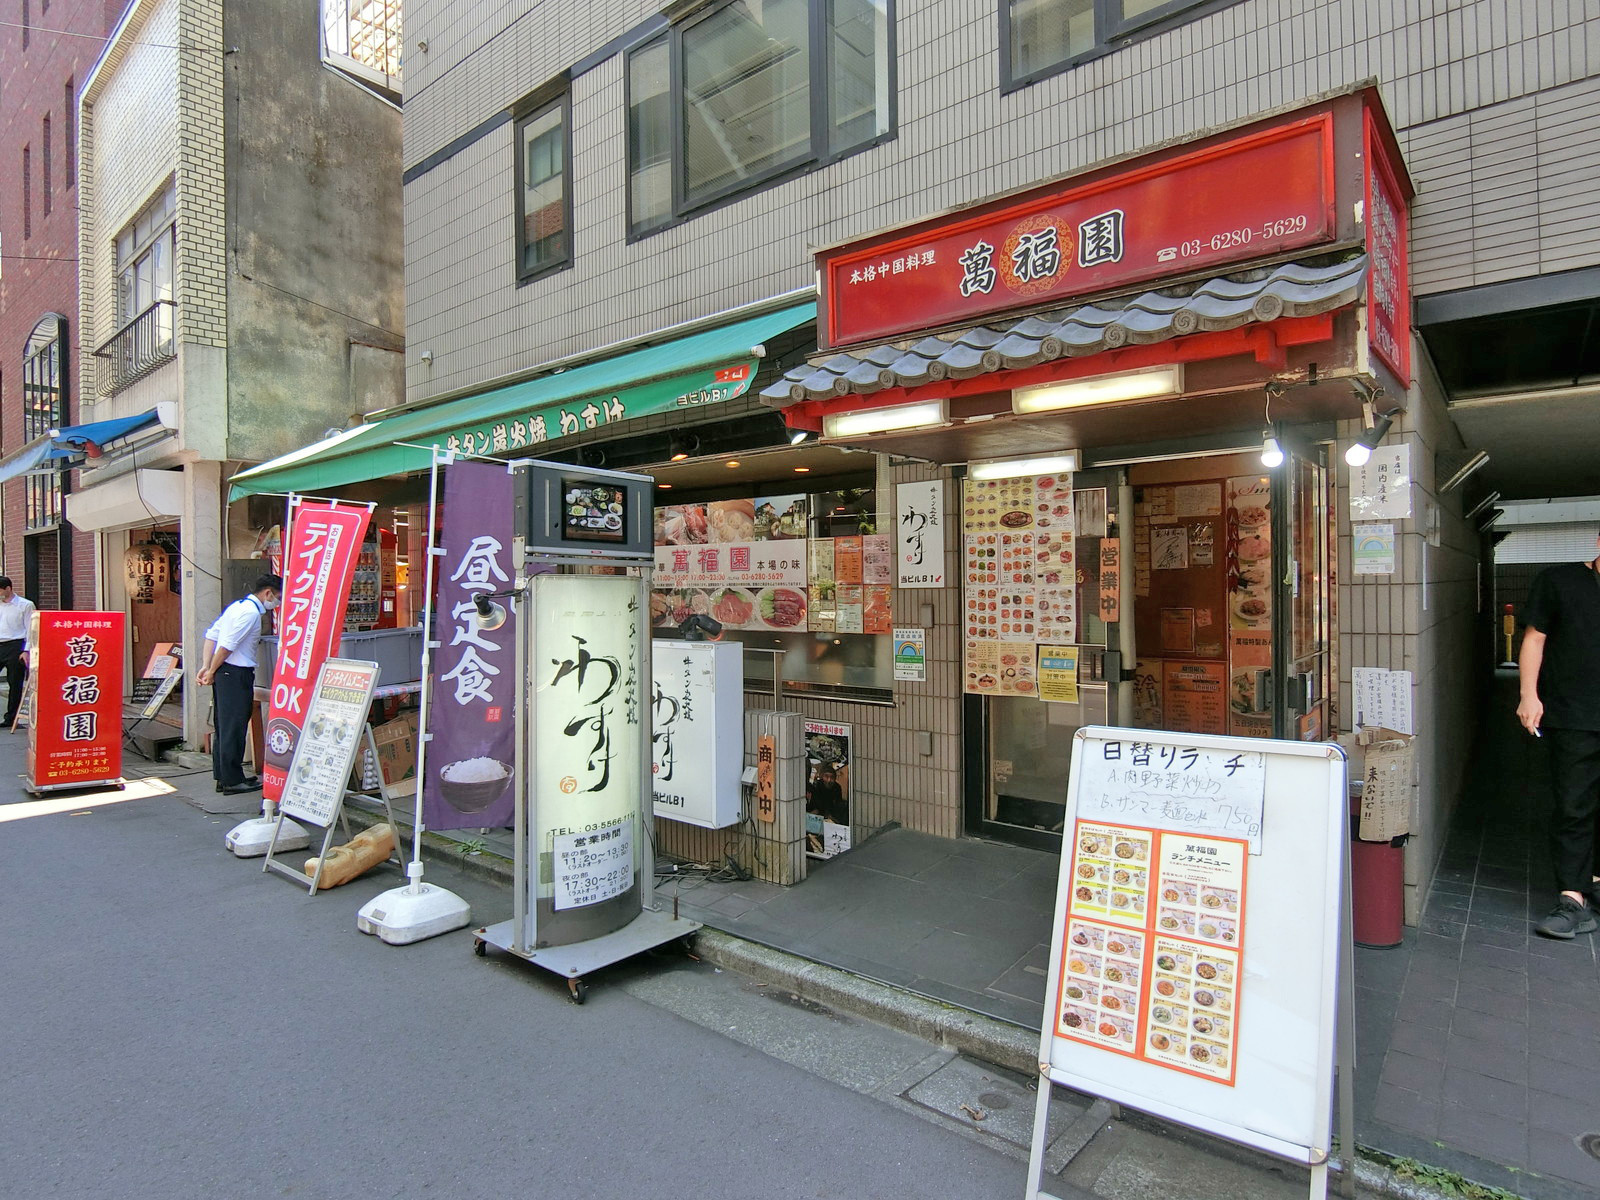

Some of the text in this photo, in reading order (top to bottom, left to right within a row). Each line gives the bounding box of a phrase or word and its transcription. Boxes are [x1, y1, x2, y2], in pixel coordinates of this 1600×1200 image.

[1181, 215, 1307, 257] 03-6280-5629
[958, 209, 1124, 297] 萬福園
[849, 249, 937, 285] 本格中国料理
[560, 396, 626, 436] わすけ
[1377, 463, 1388, 504] 国内産米
[671, 547, 750, 573] 萬福園
[756, 560, 801, 571] 本場の味
[741, 573, 784, 581] 03-6280-5629
[1101, 546, 1119, 616] 営業中
[281, 522, 328, 676] テイクアウト
[53, 620, 112, 630] 本格中国料理
[441, 535, 510, 706] 昼定食
[62, 632, 101, 742] 萬福園
[325, 669, 370, 690] ランチタイムメニュー
[274, 683, 303, 714] OK
[551, 634, 622, 795] わすけ
[50, 758, 109, 769] ご予約承ります
[58, 766, 110, 776] 03-6280-5629
[574, 827, 621, 847] 営業時間
[561, 848, 588, 859] 昼の部
[1171, 852, 1231, 867] ランチメニュー
[1185, 844, 1218, 856] 萬福園
[562, 871, 589, 881] 夜の部
[574, 893, 597, 905] 定休日
